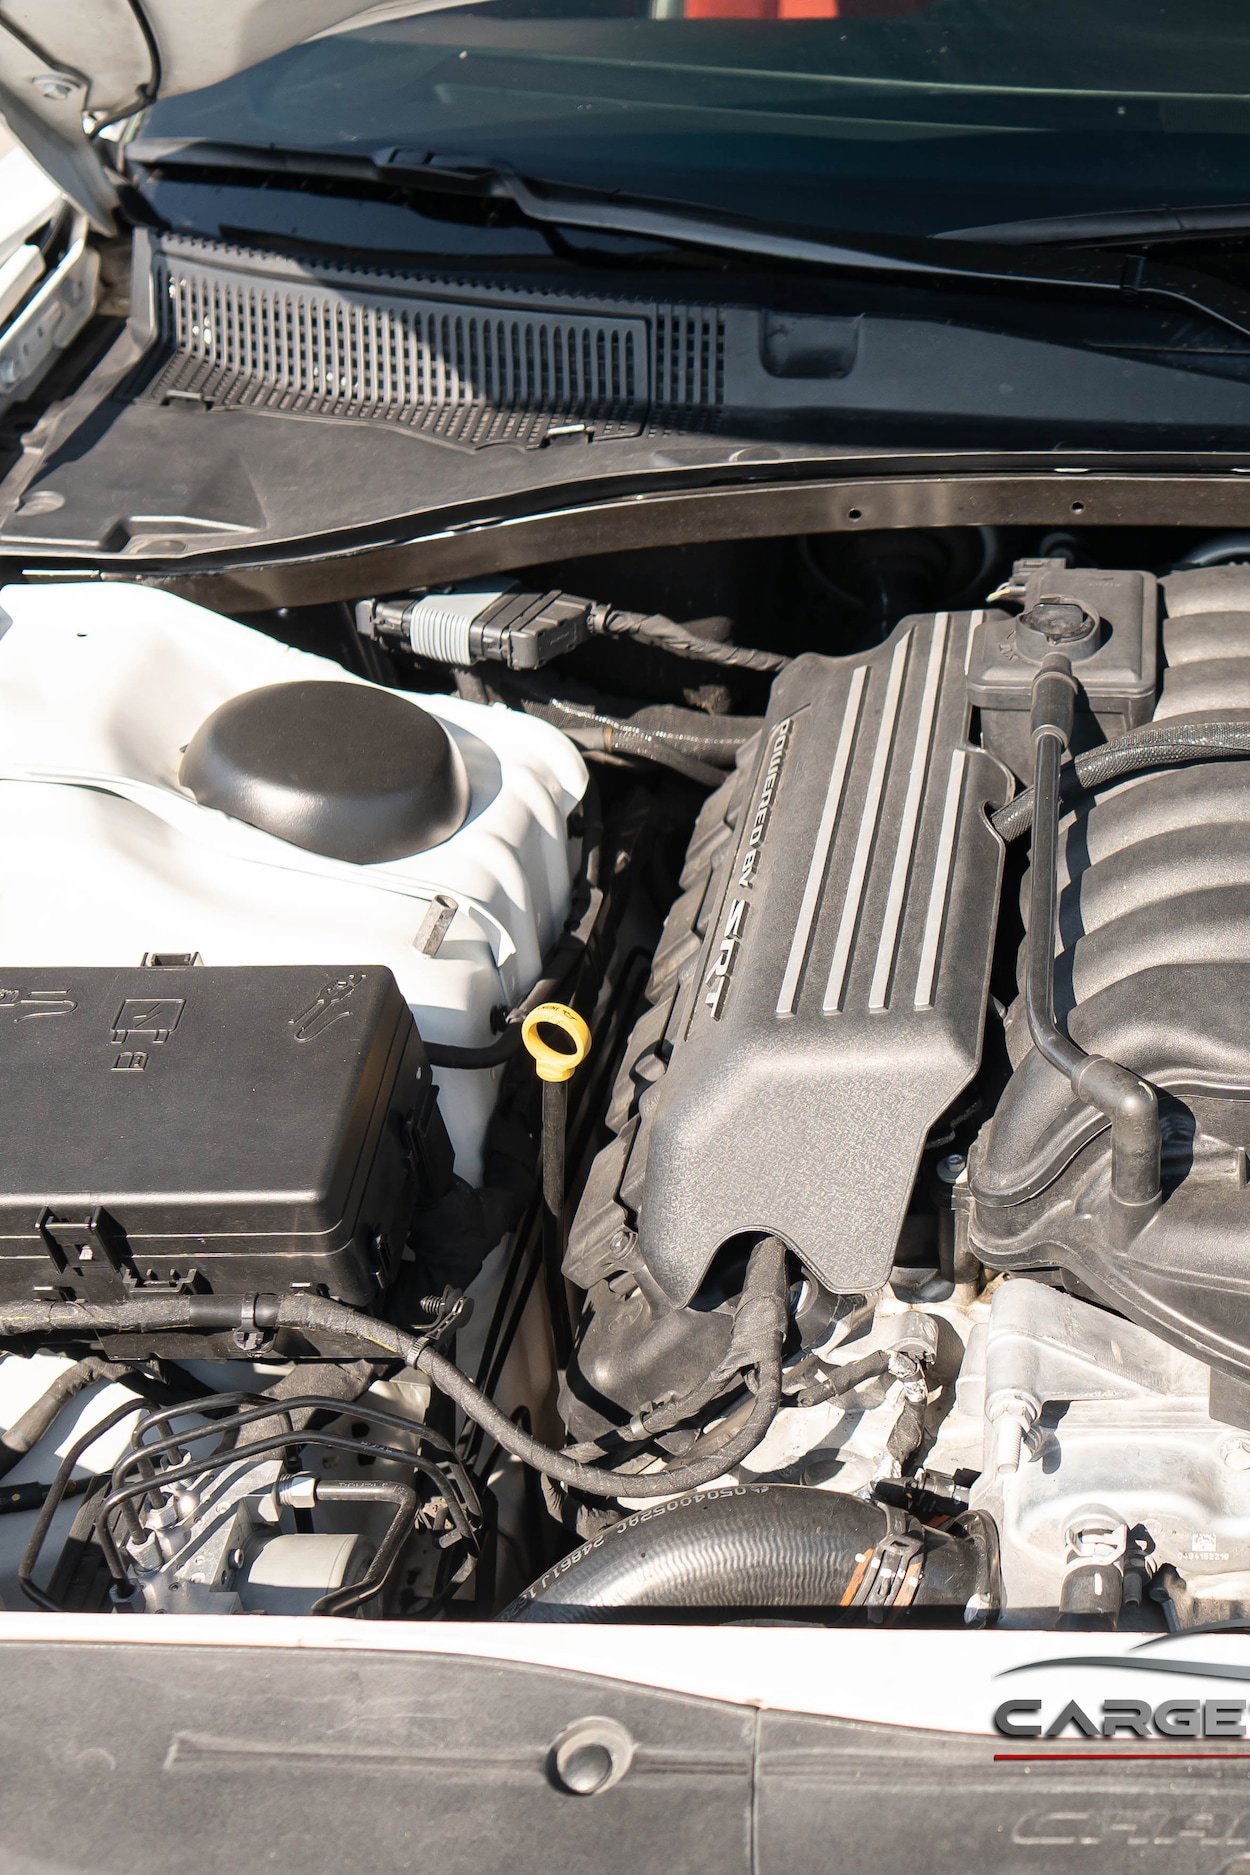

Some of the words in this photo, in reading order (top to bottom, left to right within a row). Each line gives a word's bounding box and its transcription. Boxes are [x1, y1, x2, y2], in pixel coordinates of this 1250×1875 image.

[747, 717, 794, 848] POWERED
[737, 847, 762, 890] BY
[703, 897, 751, 1022] SRT
[615, 1484, 747, 1535] 05040052AC
[540, 1535, 605, 1589] 24861J
